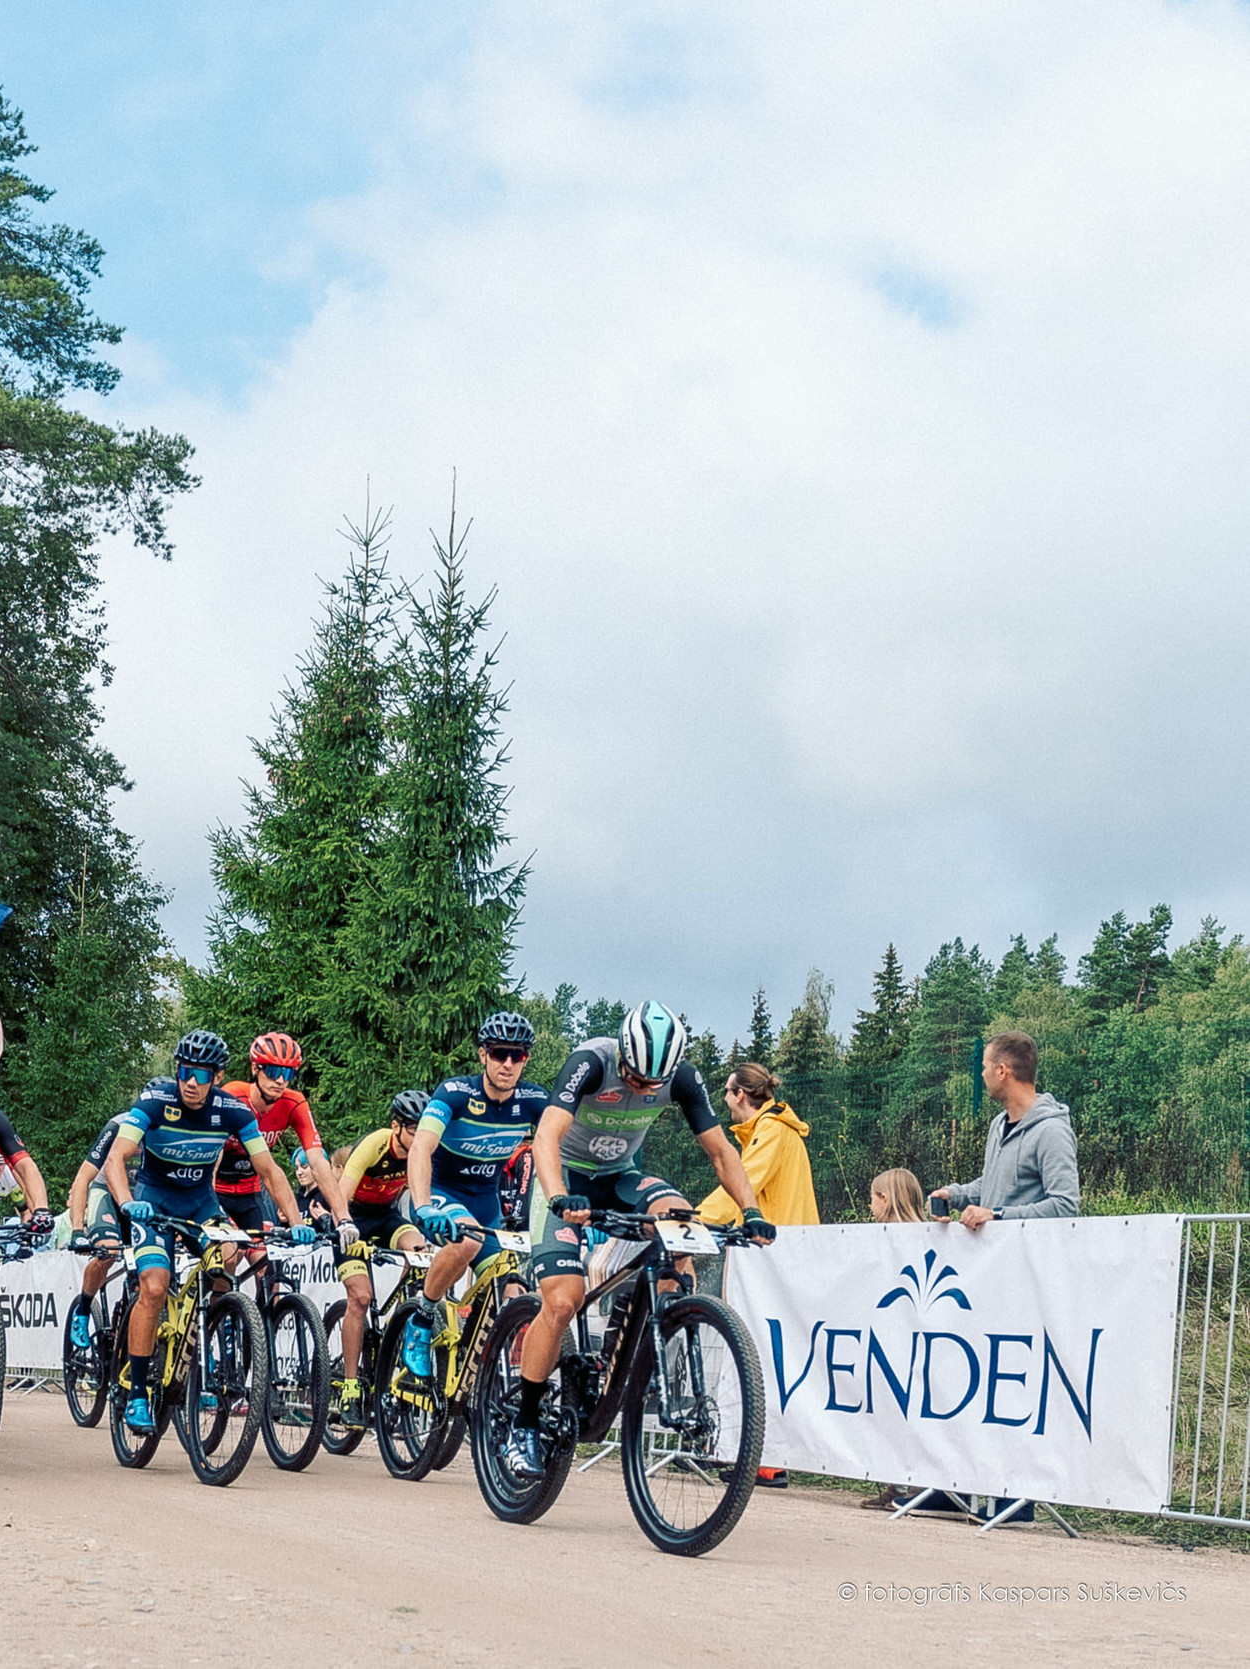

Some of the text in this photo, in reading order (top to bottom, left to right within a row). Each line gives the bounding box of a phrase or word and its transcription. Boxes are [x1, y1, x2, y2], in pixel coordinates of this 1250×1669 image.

[565, 1061, 591, 1092] Dobele
[605, 1115, 653, 1126] Dobele
[512, 1234, 525, 1246] 3
[678, 1223, 696, 1241] 2
[0, 1286, 58, 1328] ŠKODA
[764, 1318, 1105, 1443] VENDEN
